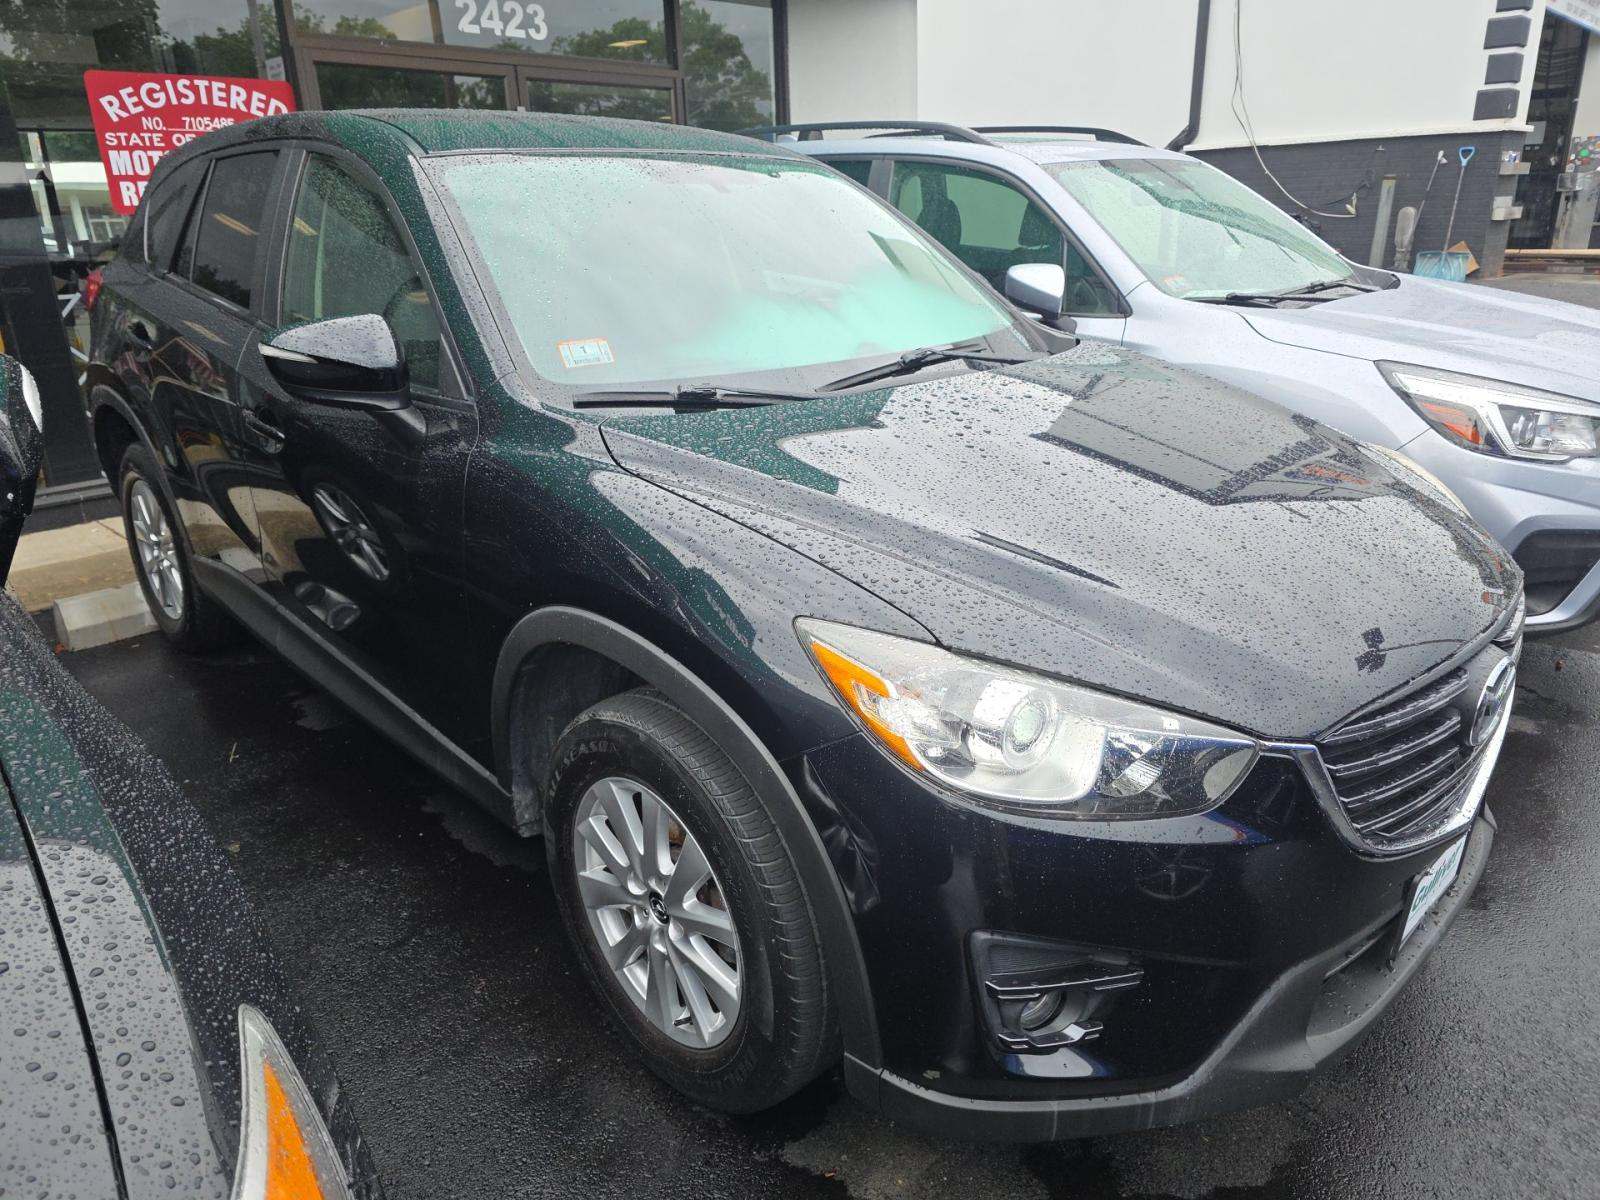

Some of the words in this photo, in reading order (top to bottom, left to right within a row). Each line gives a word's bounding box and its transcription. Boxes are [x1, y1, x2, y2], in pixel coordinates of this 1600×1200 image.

[455, 0, 548, 40] 2423
[99, 79, 288, 122] REGISTERED
[142, 117, 167, 131] NO.
[105, 132, 165, 147] STATE
[108, 150, 169, 175] MOT
